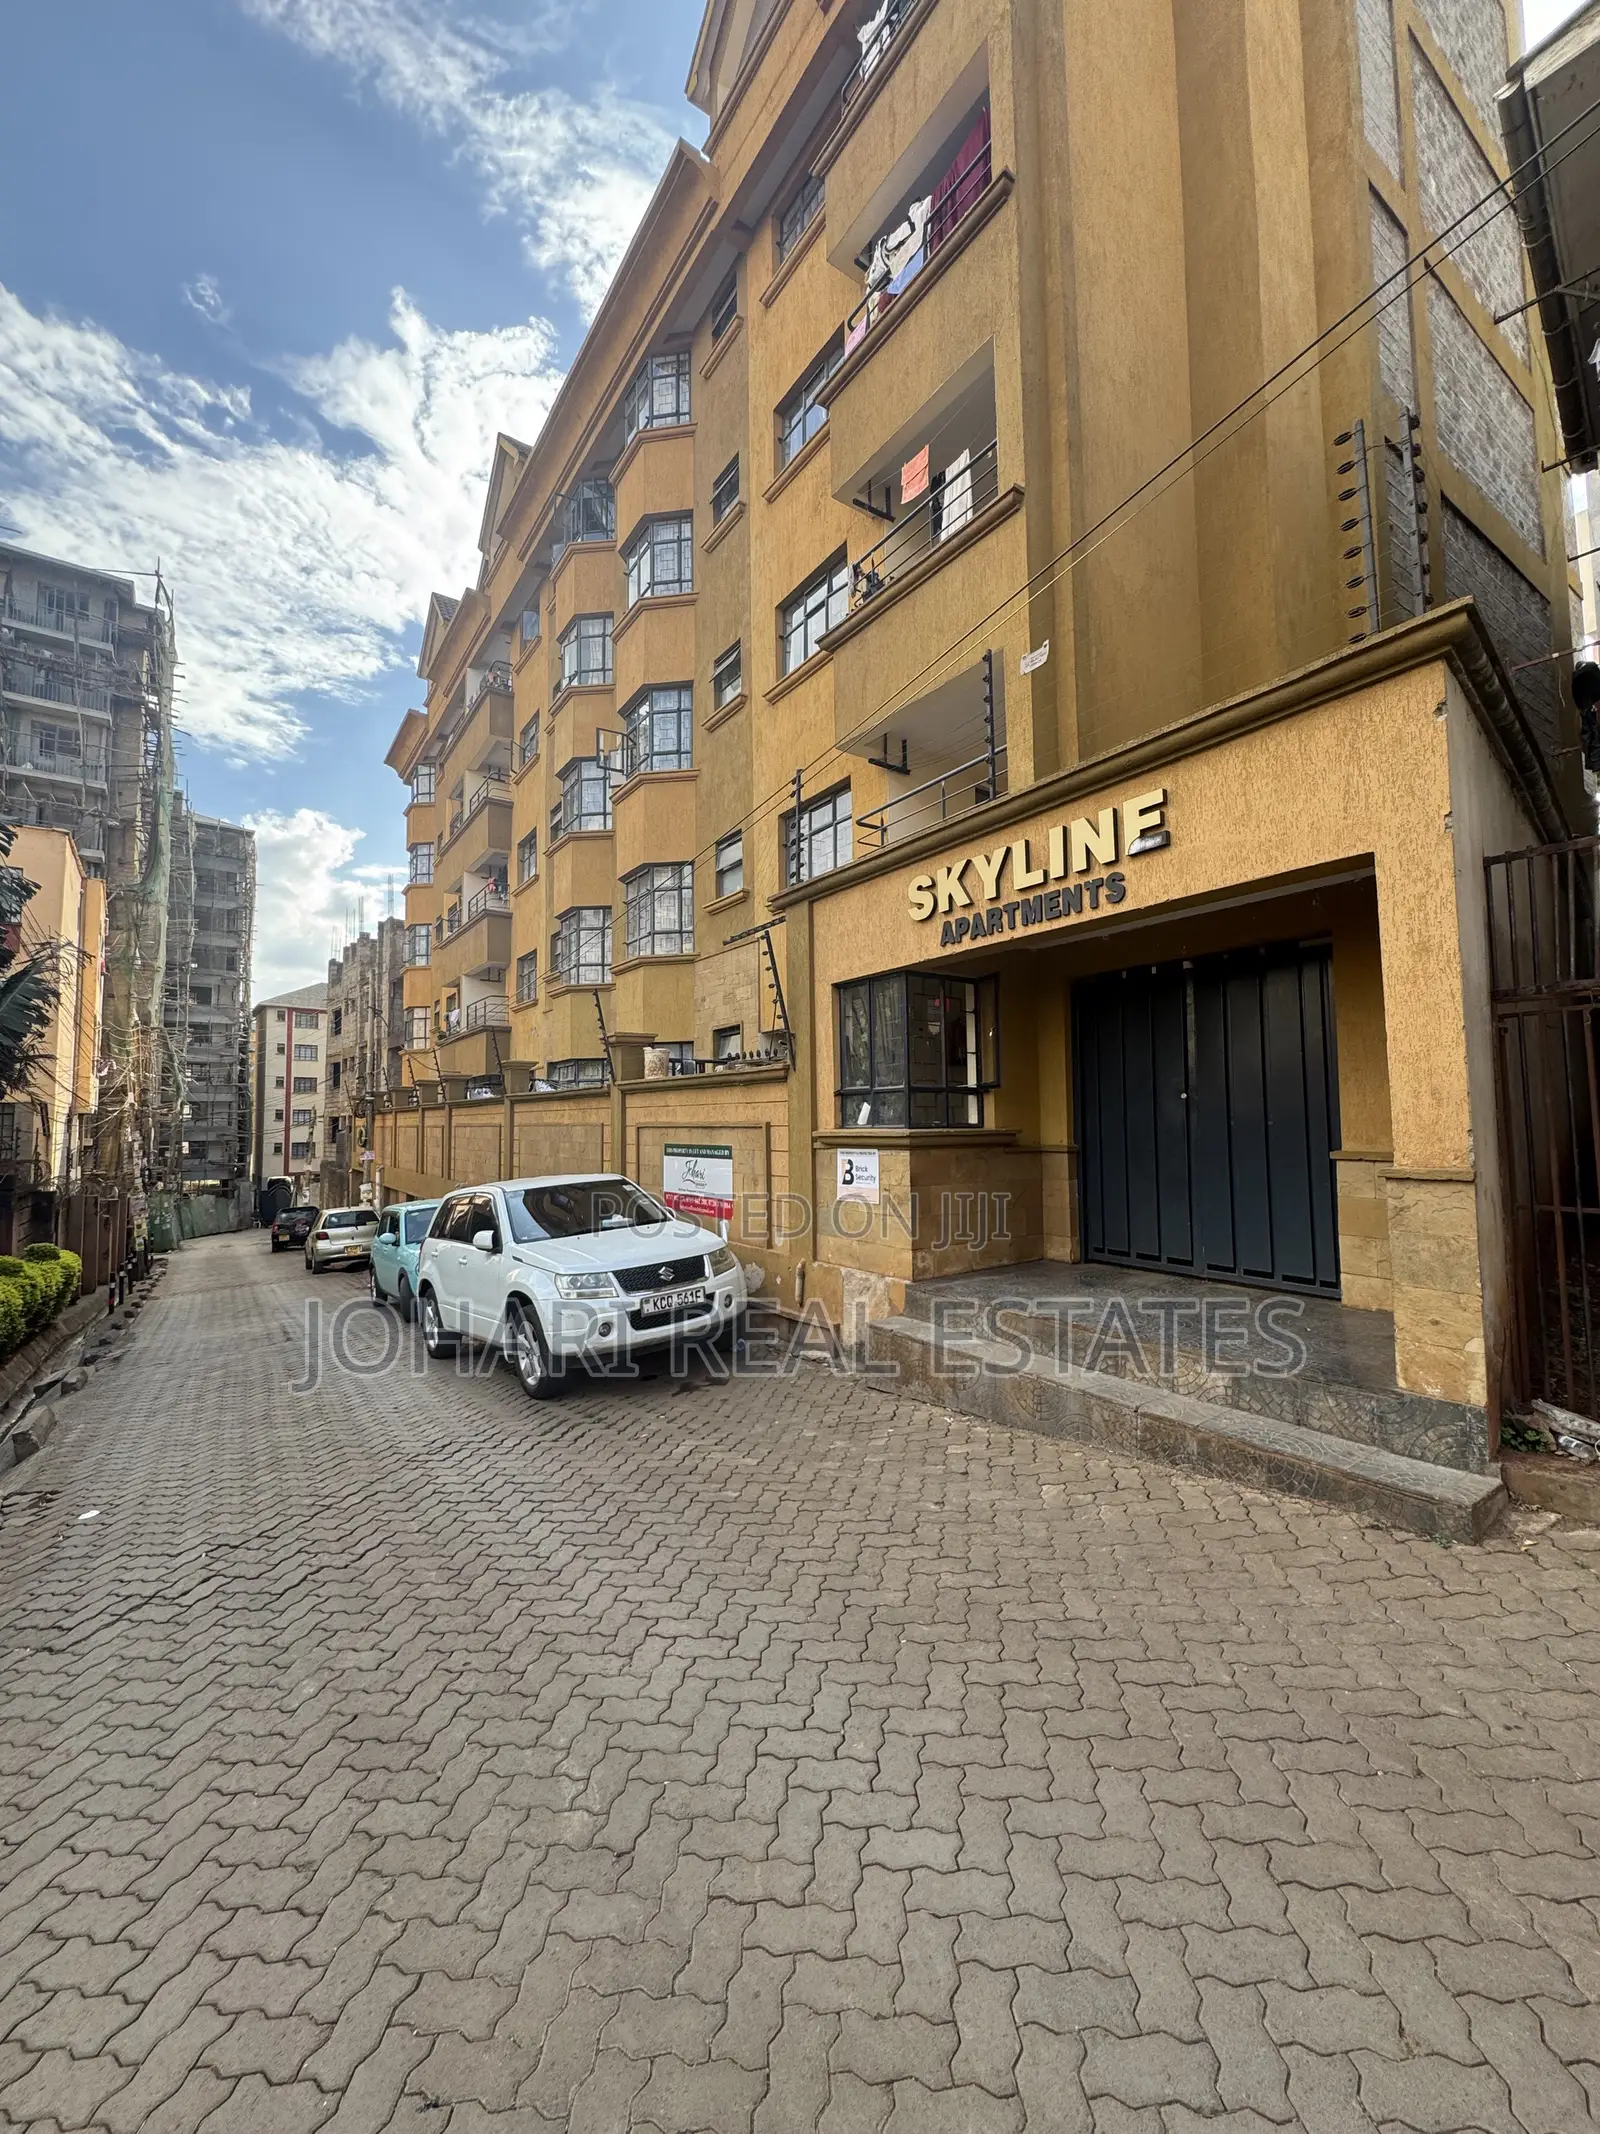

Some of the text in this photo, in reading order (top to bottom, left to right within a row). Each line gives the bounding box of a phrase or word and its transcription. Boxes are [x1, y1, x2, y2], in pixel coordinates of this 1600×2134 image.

[907, 788, 1170, 922] SKYLINE
[940, 872, 1126, 946] APARTMENTS
[855, 1174, 876, 1183] Security
